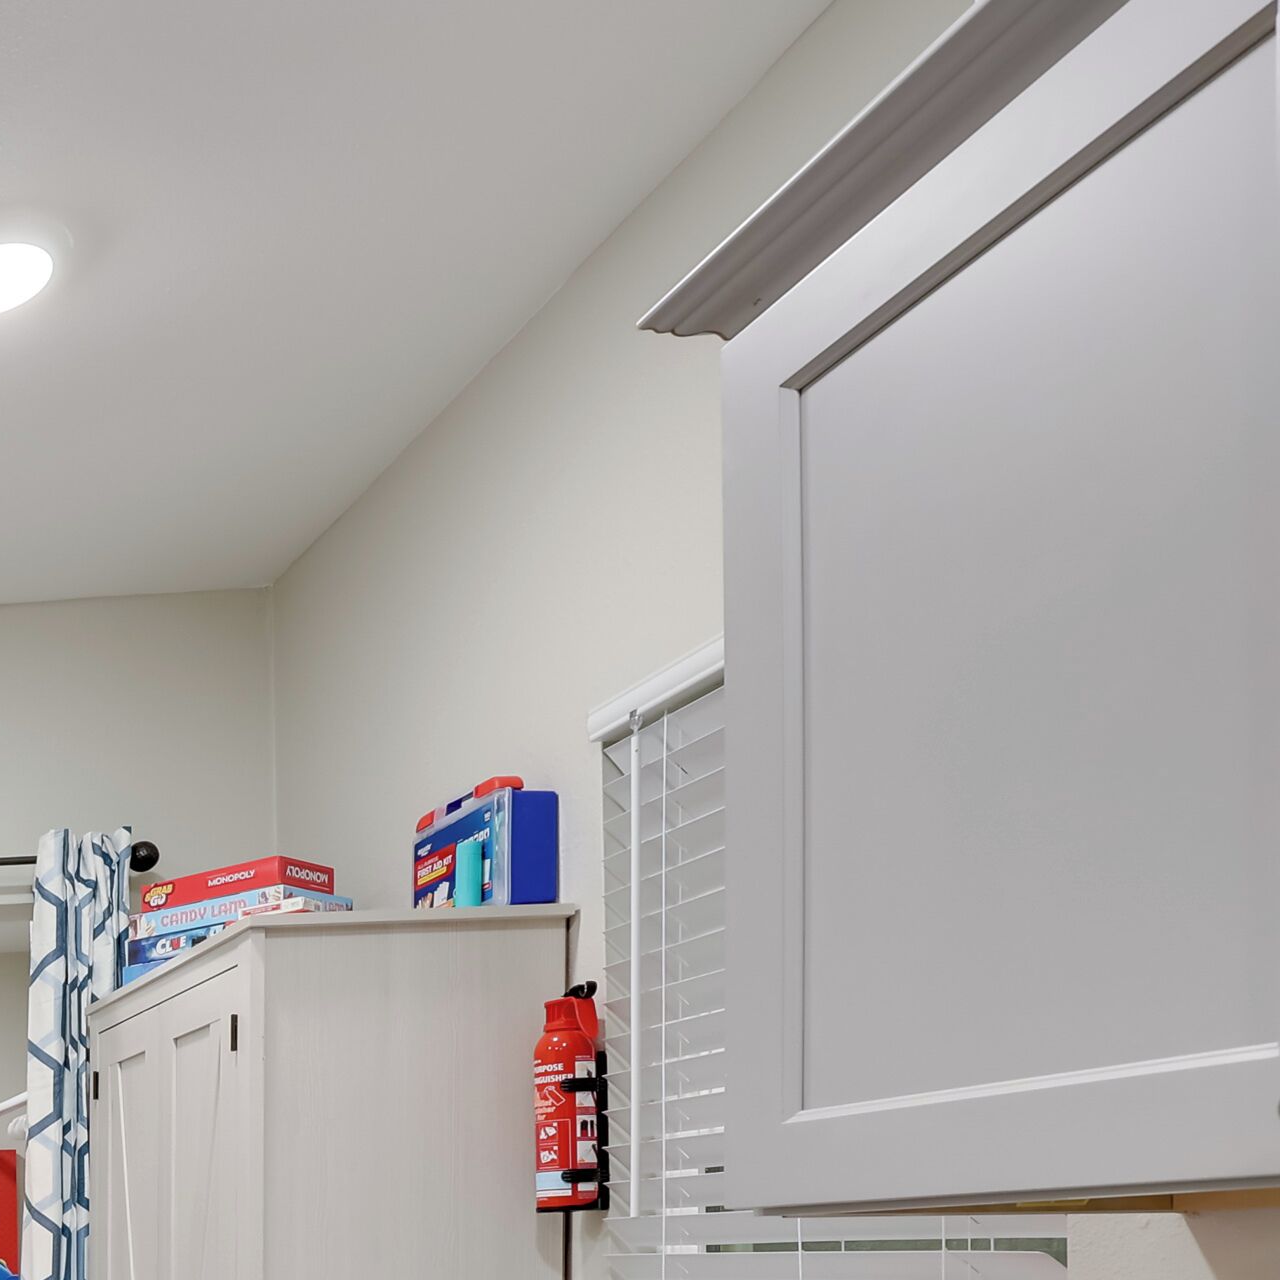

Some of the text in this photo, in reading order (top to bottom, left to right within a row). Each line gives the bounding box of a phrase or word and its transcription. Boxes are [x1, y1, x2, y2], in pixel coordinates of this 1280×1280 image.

[208, 869, 255, 887] MONOPOLY
[285, 865, 329, 884] MONOPOLY
[417, 863, 432, 879] FIRST
[433, 859, 443, 873] AID
[151, 883, 173, 896] GRAB
[150, 893, 168, 906] GO
[160, 908, 207, 928] CANDY
[211, 898, 248, 917] LAND
[155, 935, 186, 955] CLUE
